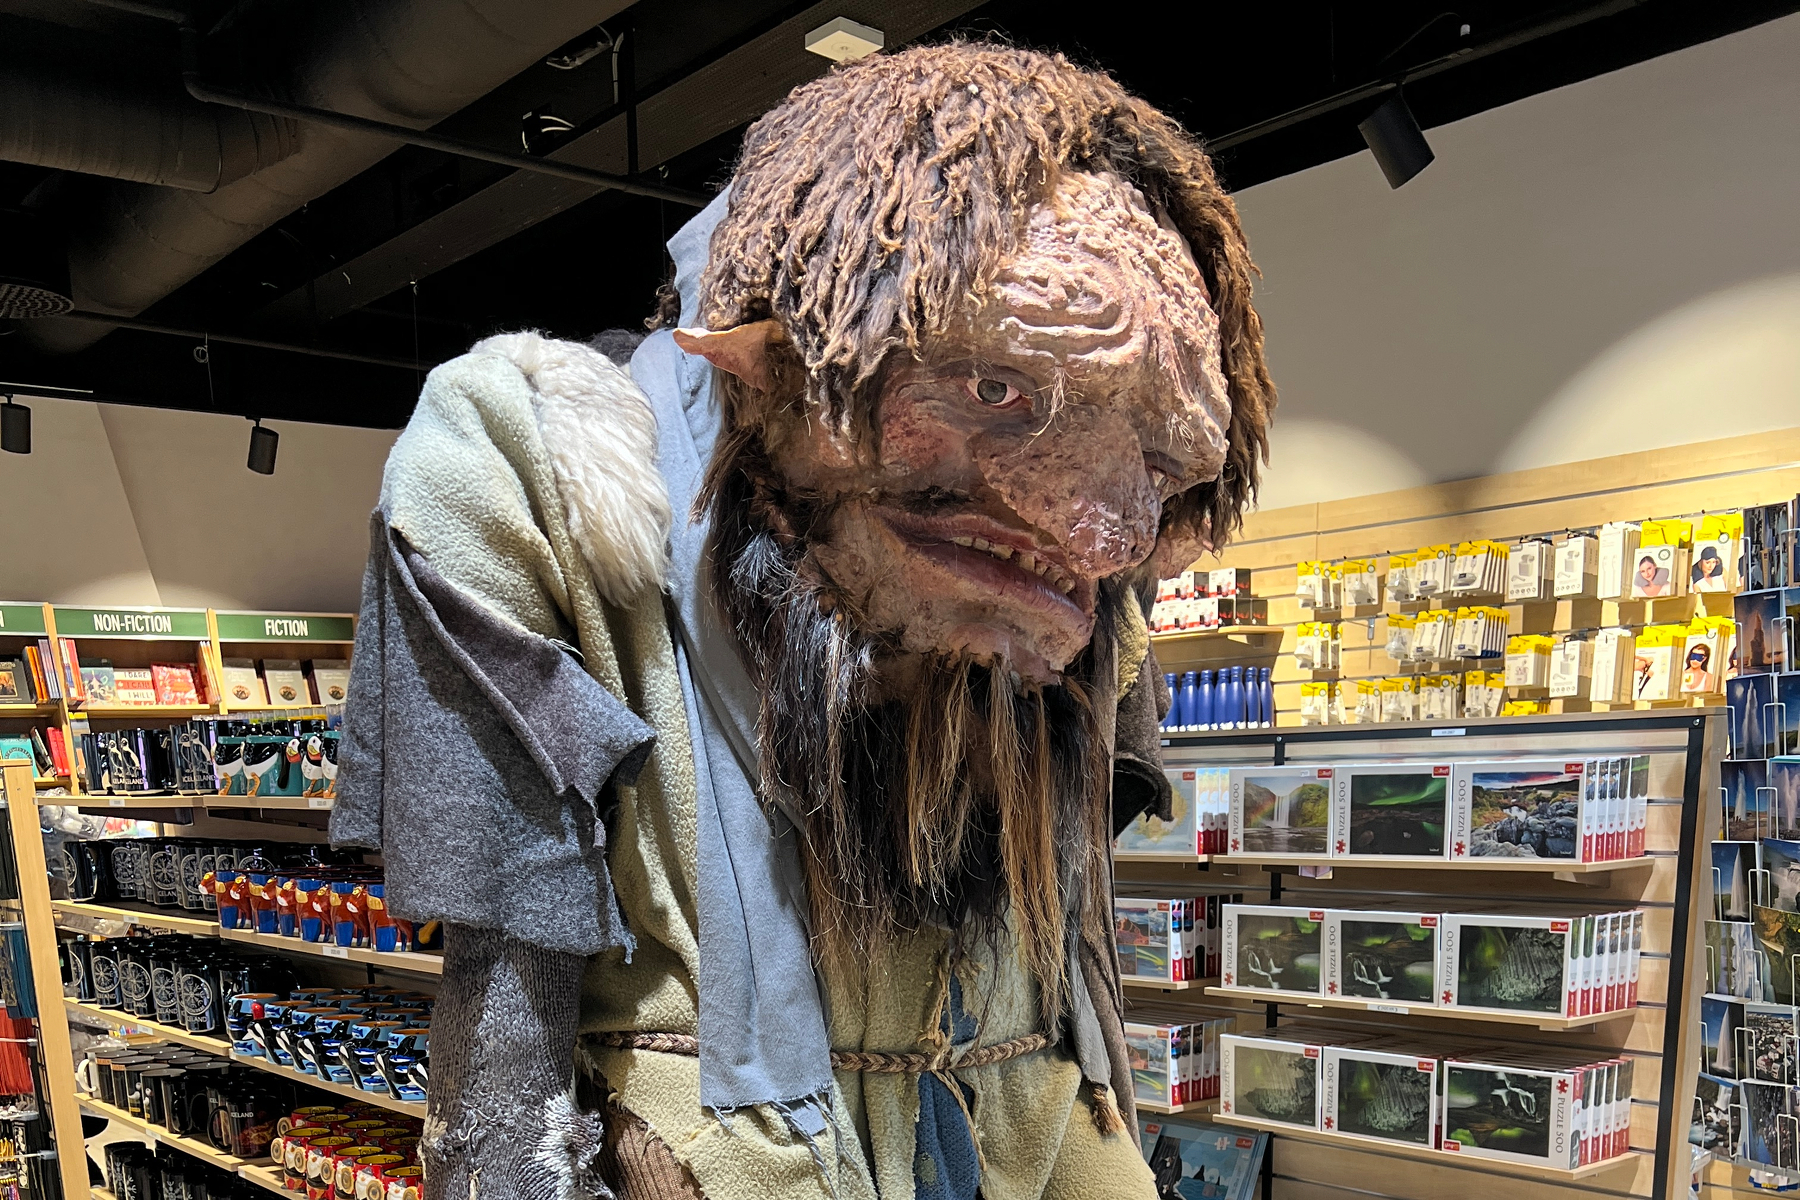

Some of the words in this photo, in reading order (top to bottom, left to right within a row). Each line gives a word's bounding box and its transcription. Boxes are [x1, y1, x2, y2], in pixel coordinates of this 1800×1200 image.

[93, 613, 172, 633] NON-FICTION
[264, 619, 309, 637] FICTION
[1458, 779, 1467, 802] 500
[1338, 806, 1346, 836] PUZZLE
[1457, 805, 1466, 838] PUZZLE
[1446, 930, 1454, 954] 500
[1445, 955, 1453, 987] PUZZLE
[1556, 1097, 1566, 1130] PUZZLE
[1555, 1131, 1564, 1154] 500
